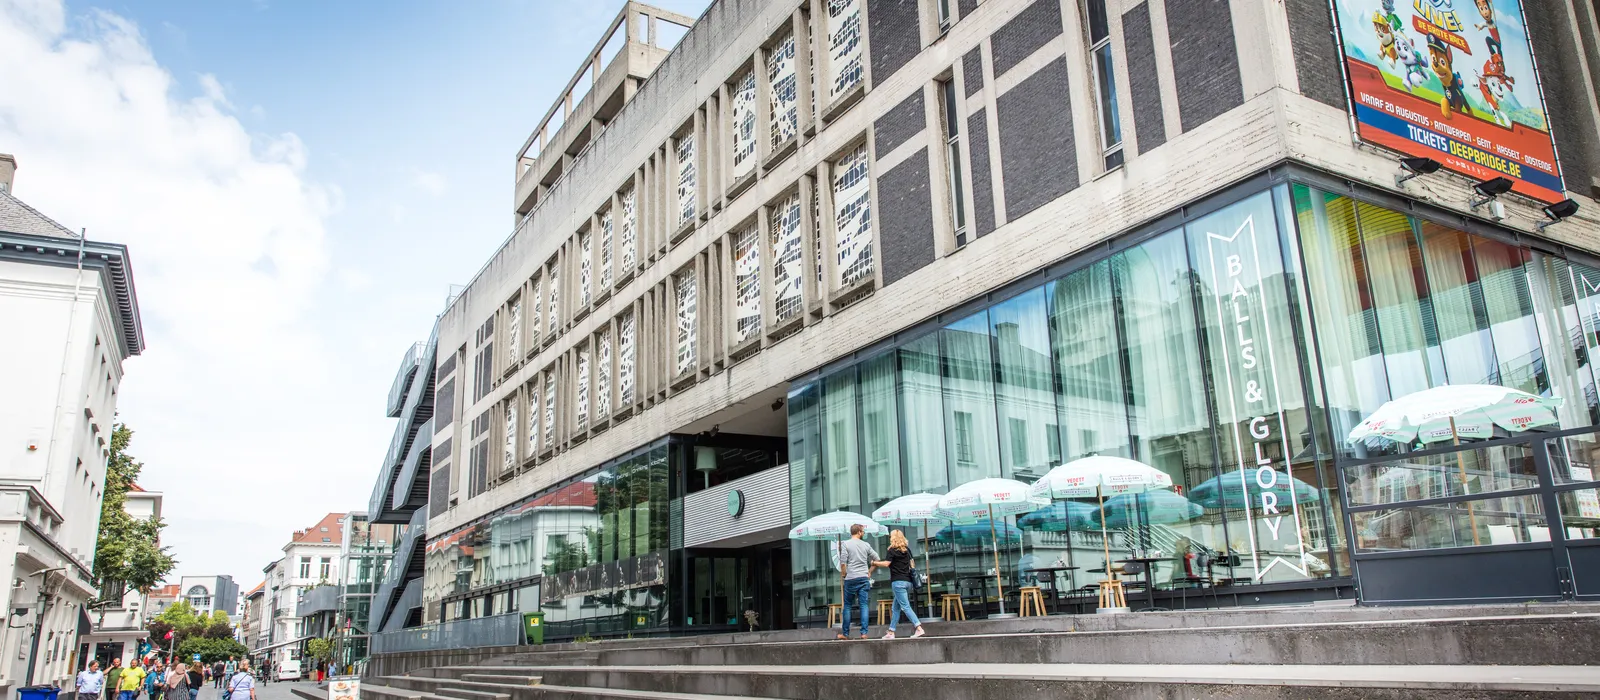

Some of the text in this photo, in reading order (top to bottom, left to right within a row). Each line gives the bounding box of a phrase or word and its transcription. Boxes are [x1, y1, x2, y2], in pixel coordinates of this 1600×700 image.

[1360, 92, 1384, 109] VANAF
[1385, 102, 1395, 113] 20
[1396, 106, 1430, 126] AUGUSTUS
[1434, 121, 1472, 142] ANTWERPEN
[1476, 137, 1492, 150] GENT
[1496, 144, 1520, 160] HASSELT
[1524, 155, 1553, 172] OOSTENDE
[1407, 124, 1448, 152] TICKETS
[1449, 139, 1522, 178] DEEPBRIDGE.BE
[1226, 254, 1282, 541] BALLS & GLORY
